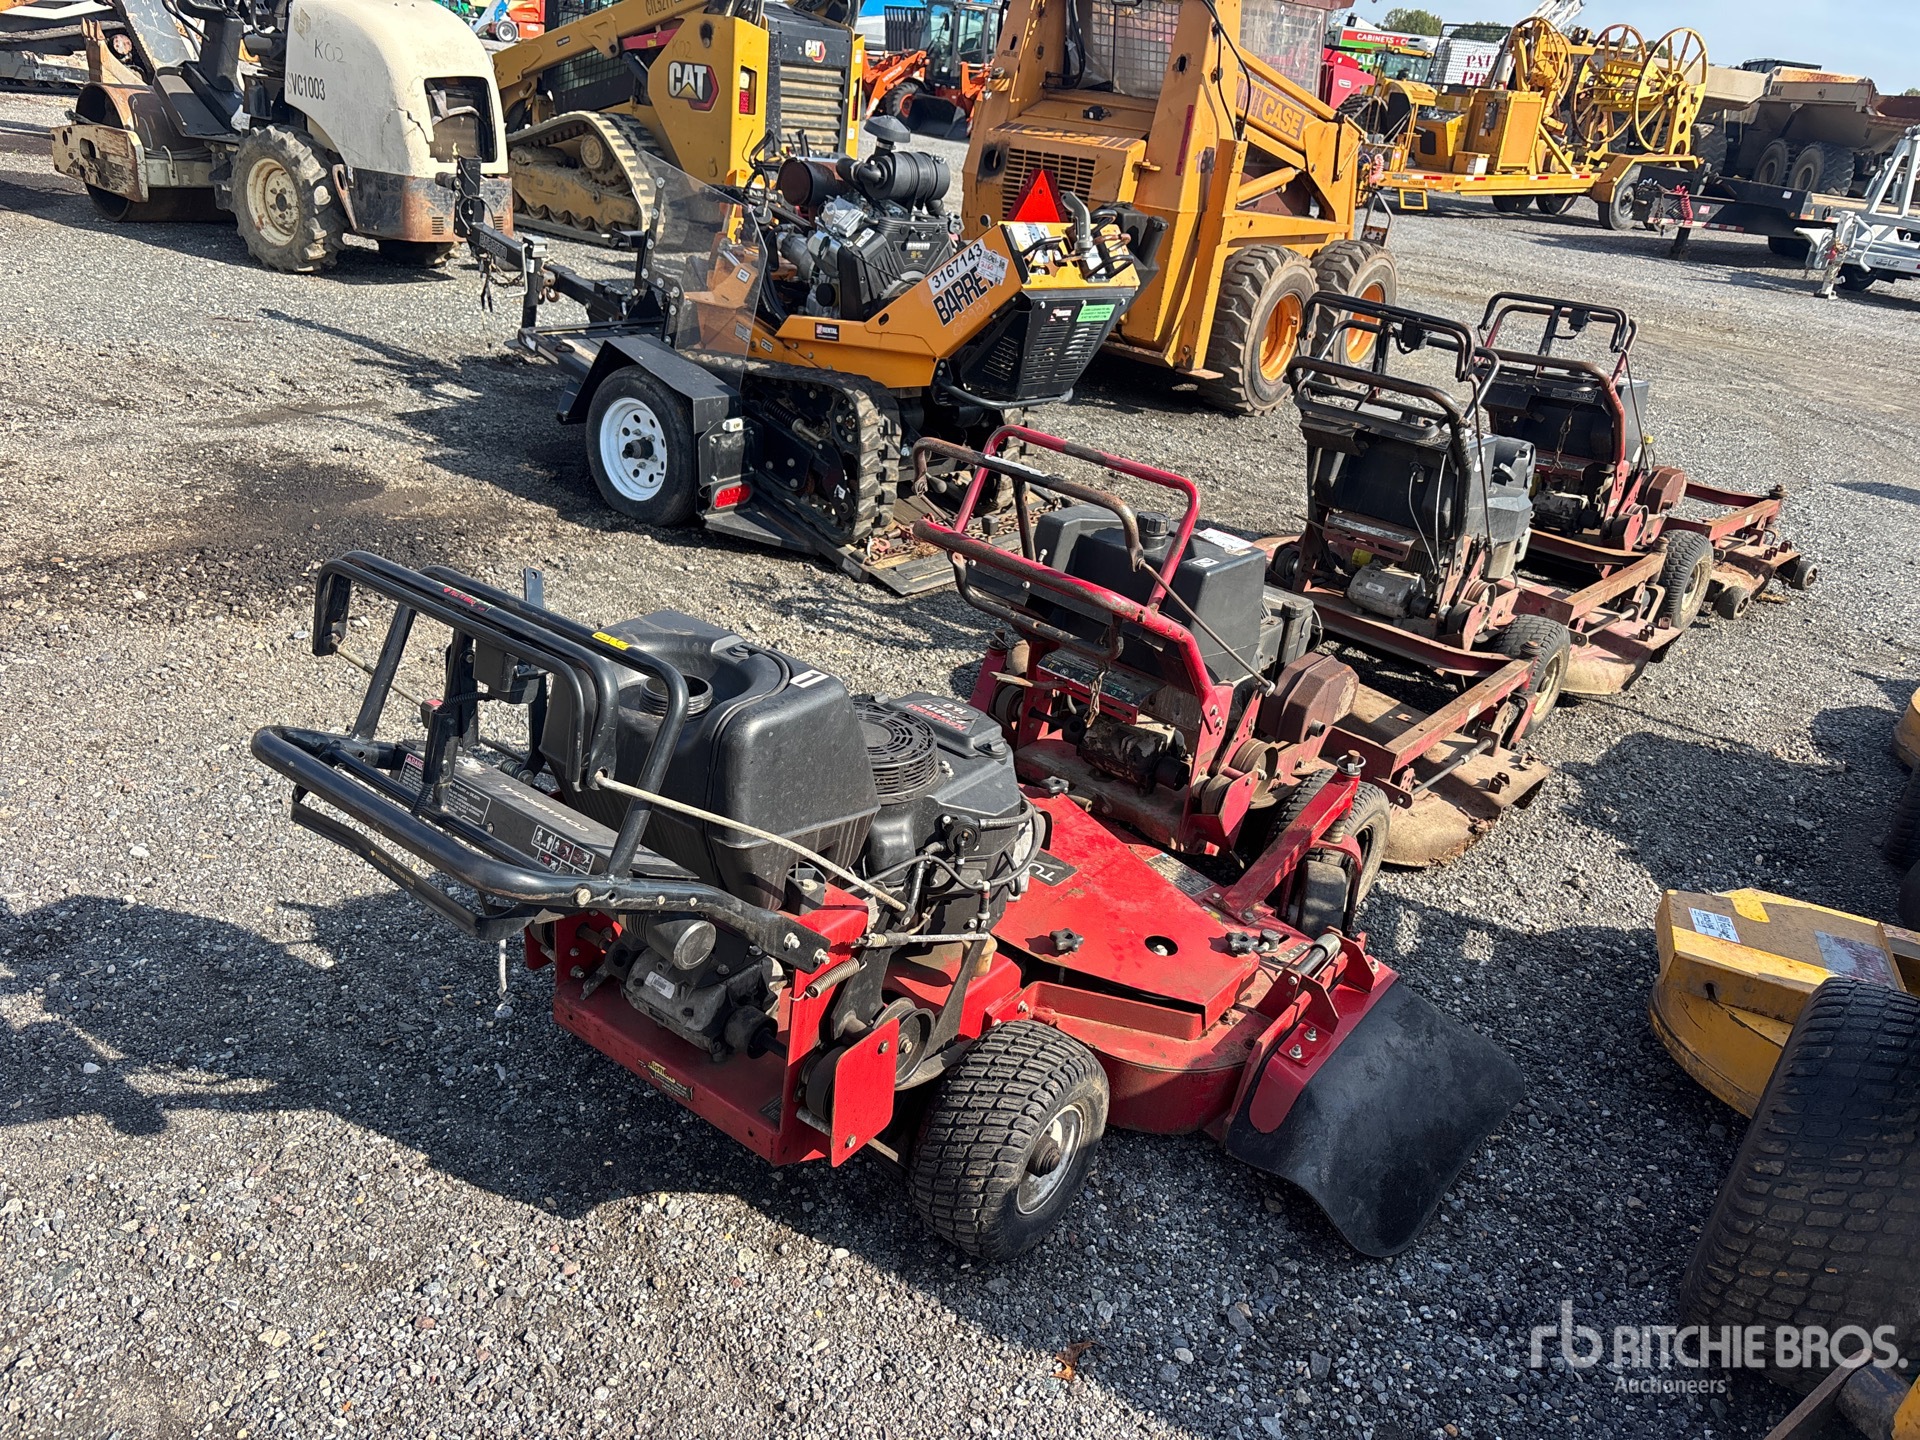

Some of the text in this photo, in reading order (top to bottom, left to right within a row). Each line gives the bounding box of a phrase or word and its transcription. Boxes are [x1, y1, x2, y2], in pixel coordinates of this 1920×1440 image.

[804, 39, 821, 57] CAT
[1356, 33, 1394, 44] CABINETS
[668, 61, 707, 100] CAT
[1261, 97, 1303, 138] CASE
[932, 244, 983, 289] 3167143
[796, 673, 822, 685] 1
[905, 703, 968, 731] Kawasaki
